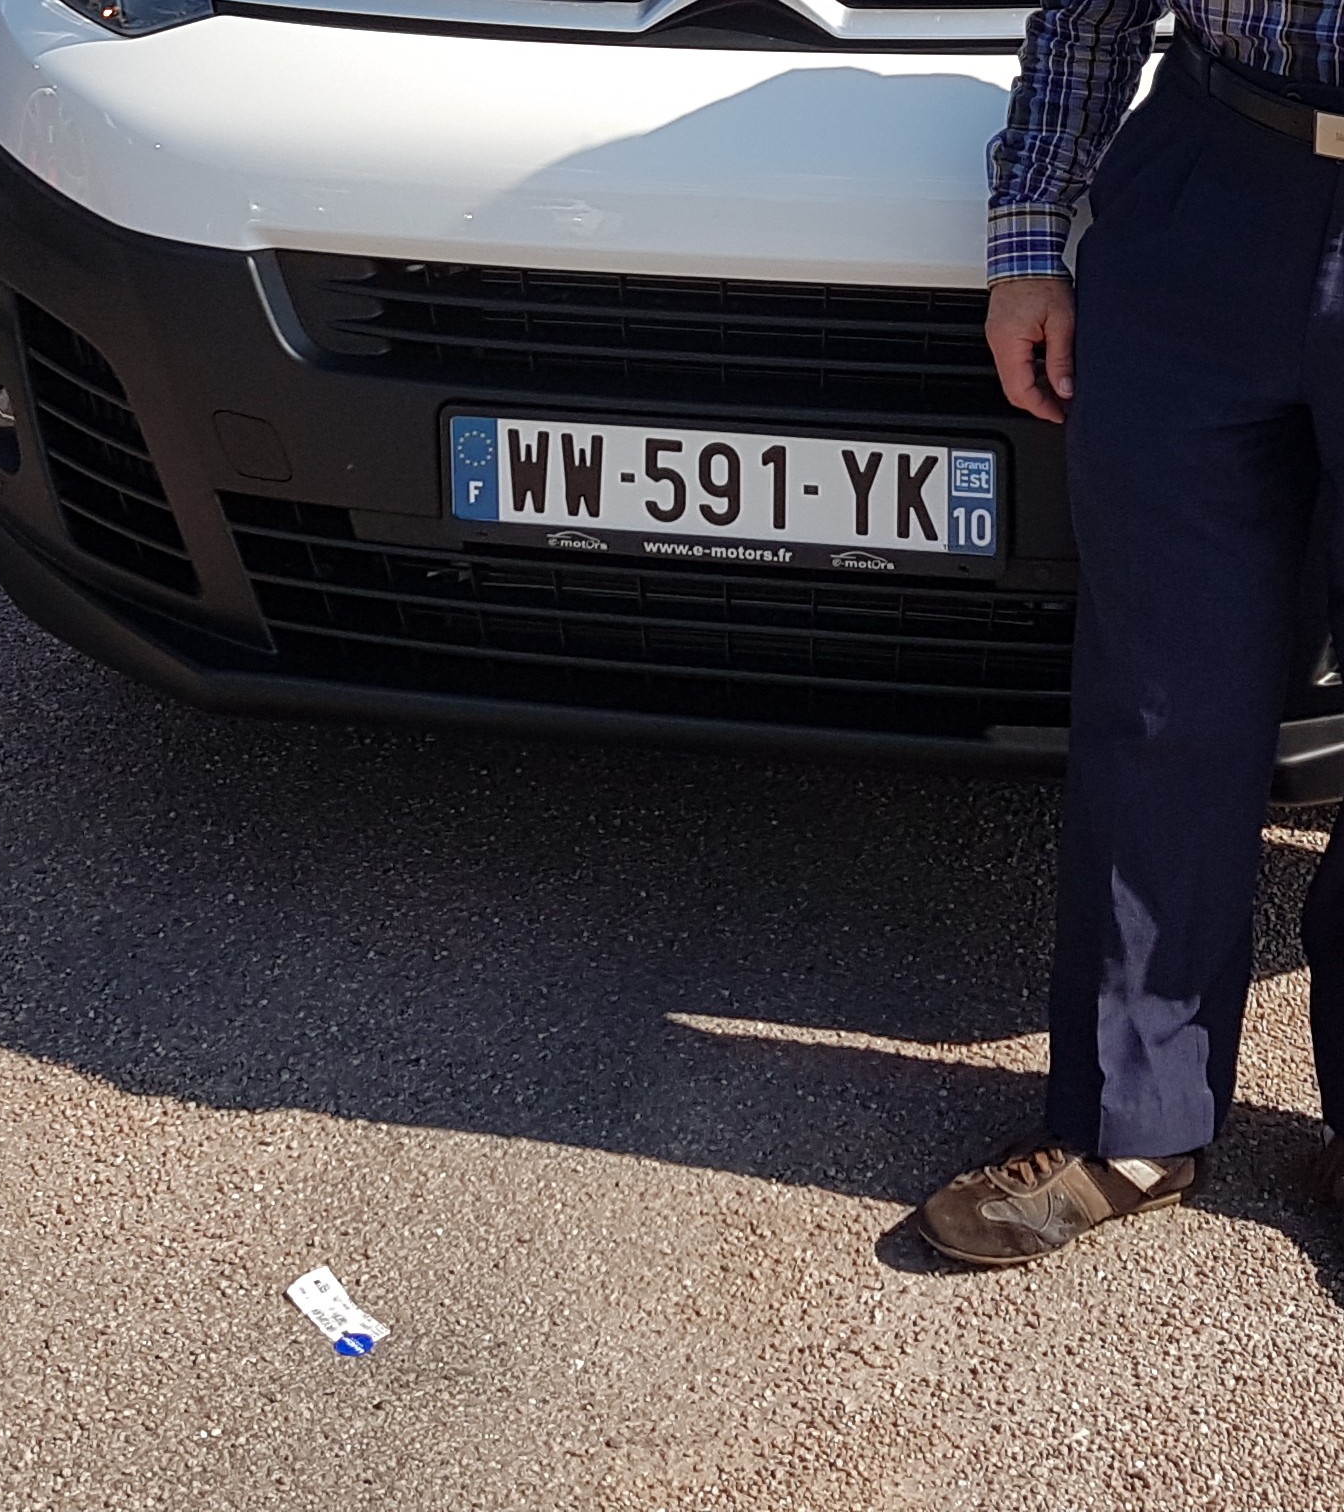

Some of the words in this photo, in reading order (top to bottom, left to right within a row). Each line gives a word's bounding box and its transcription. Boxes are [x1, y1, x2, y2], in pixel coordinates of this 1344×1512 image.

[956, 459, 989, 470] Grand
[508, 428, 939, 541] WW-591-YK
[956, 469, 989, 488] Est
[469, 481, 483, 503] F
[953, 507, 991, 547] 10
[644, 541, 793, 563] www.e-motors.fr
